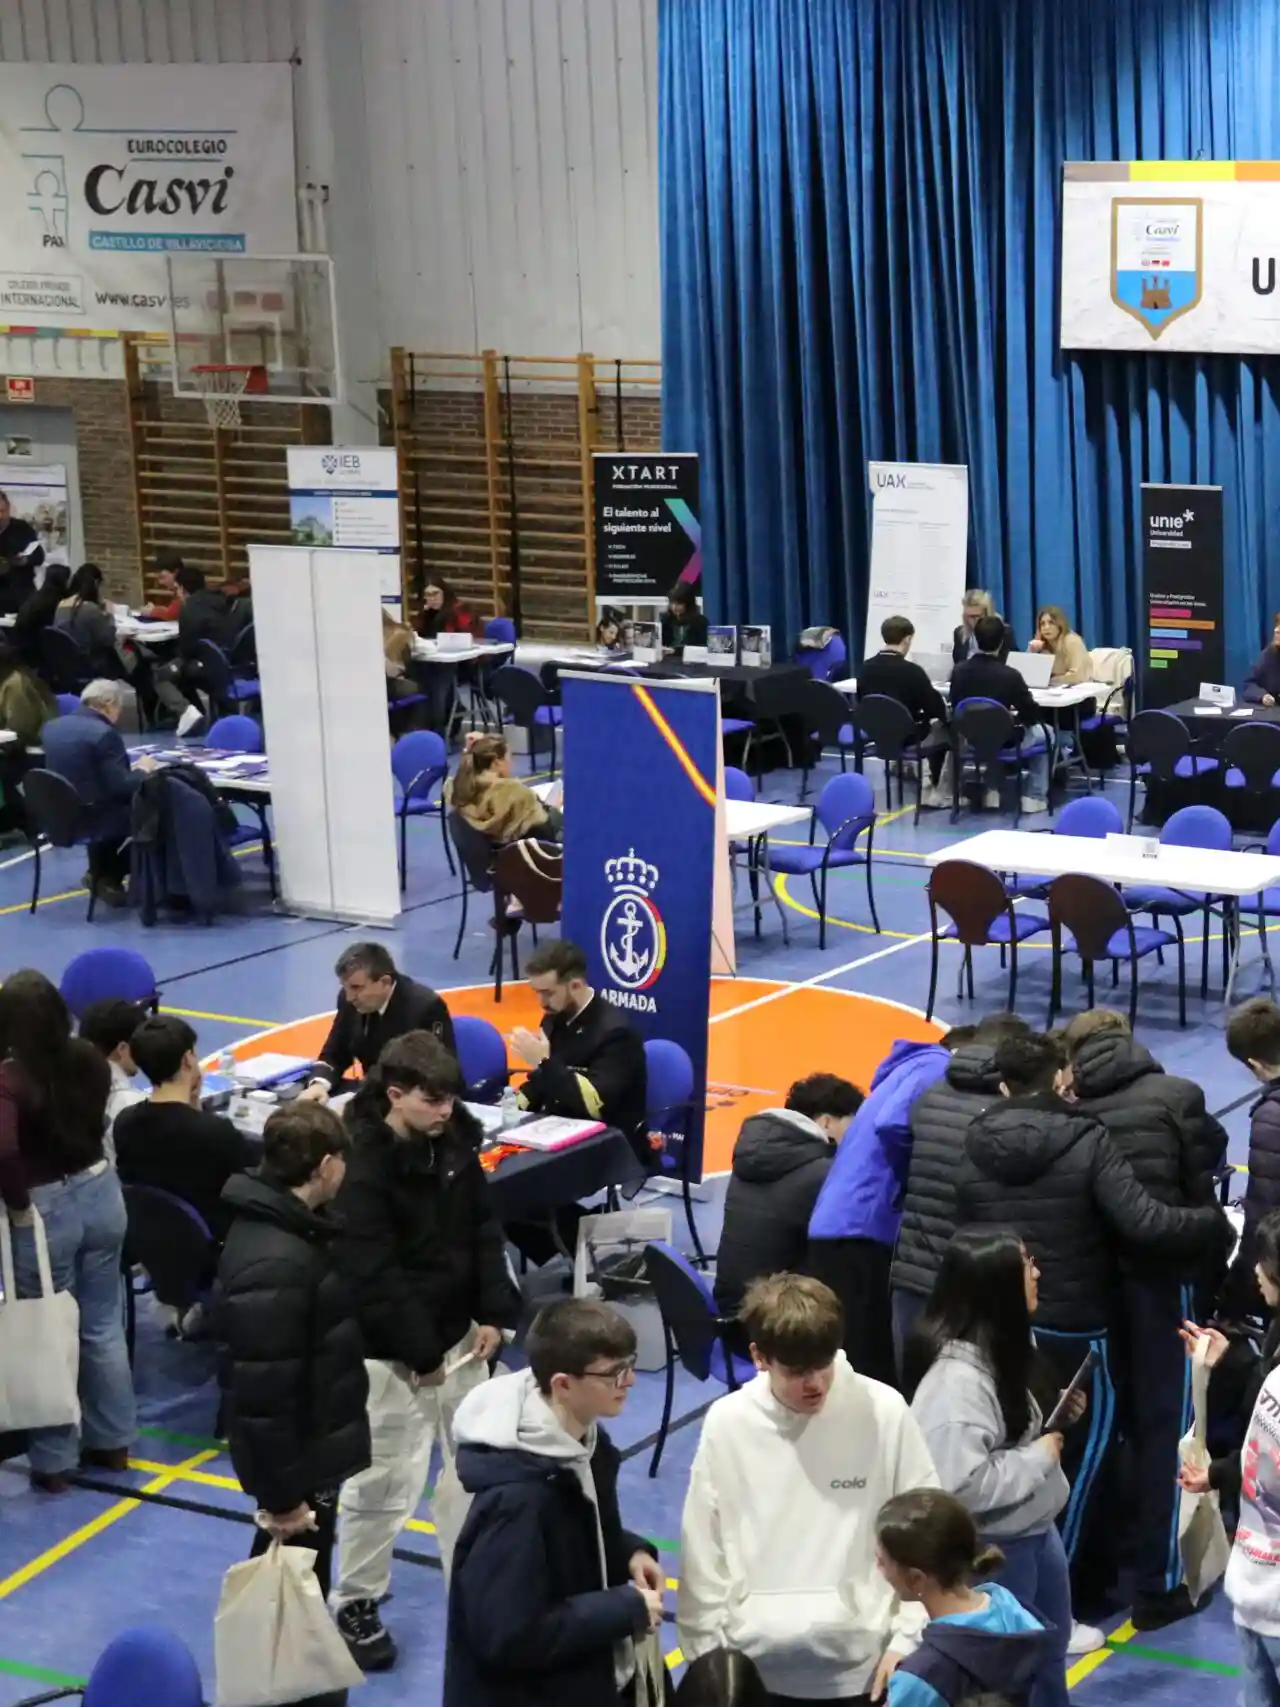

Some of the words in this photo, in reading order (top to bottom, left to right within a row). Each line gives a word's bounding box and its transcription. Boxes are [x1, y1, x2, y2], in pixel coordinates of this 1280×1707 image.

[127, 139, 227, 154] EUROCOLEGIO
[84, 164, 234, 215] Casvi
[339, 454, 361, 468] IEB
[612, 465, 679, 480] XTART
[877, 472, 906, 488] UAX
[603, 506, 613, 517] El
[615, 506, 649, 518] talento
[650, 507, 659, 517] al
[603, 522, 646, 535] siguiente
[648, 522, 672, 533] nivel
[600, 988, 657, 1013] ARMADA
[830, 1475, 867, 1489] cold
